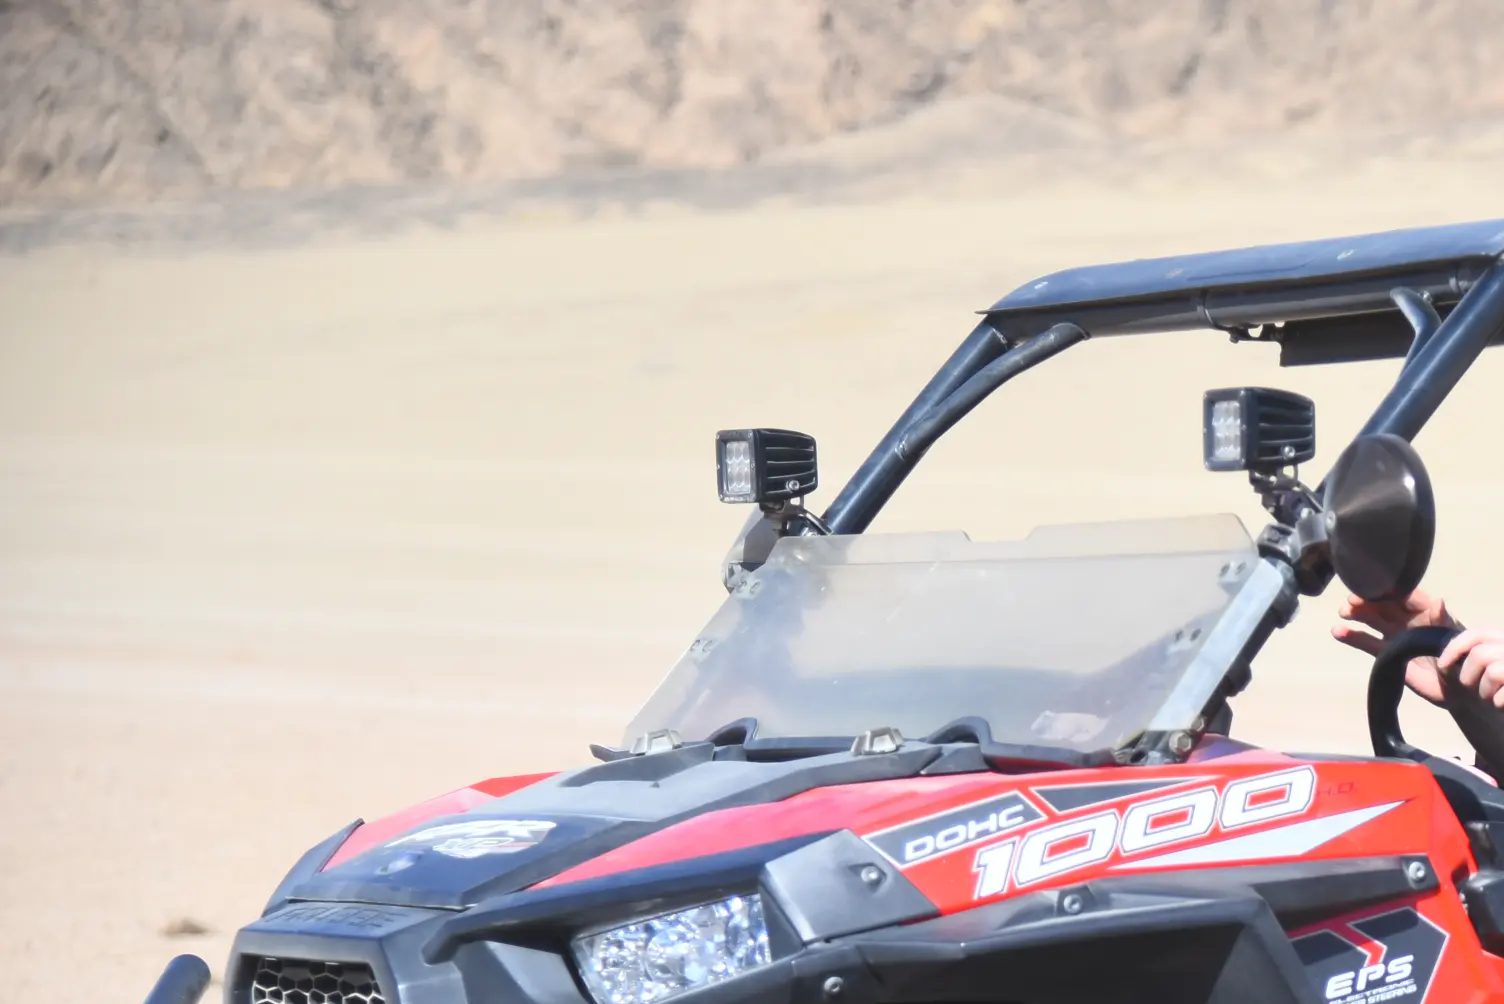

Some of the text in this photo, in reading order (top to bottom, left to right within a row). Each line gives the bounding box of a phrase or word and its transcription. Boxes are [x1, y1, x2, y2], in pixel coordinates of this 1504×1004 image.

[903, 804, 1026, 860] DOHC
[972, 766, 1316, 901] 1000
[1325, 954, 1414, 1000] EPS
